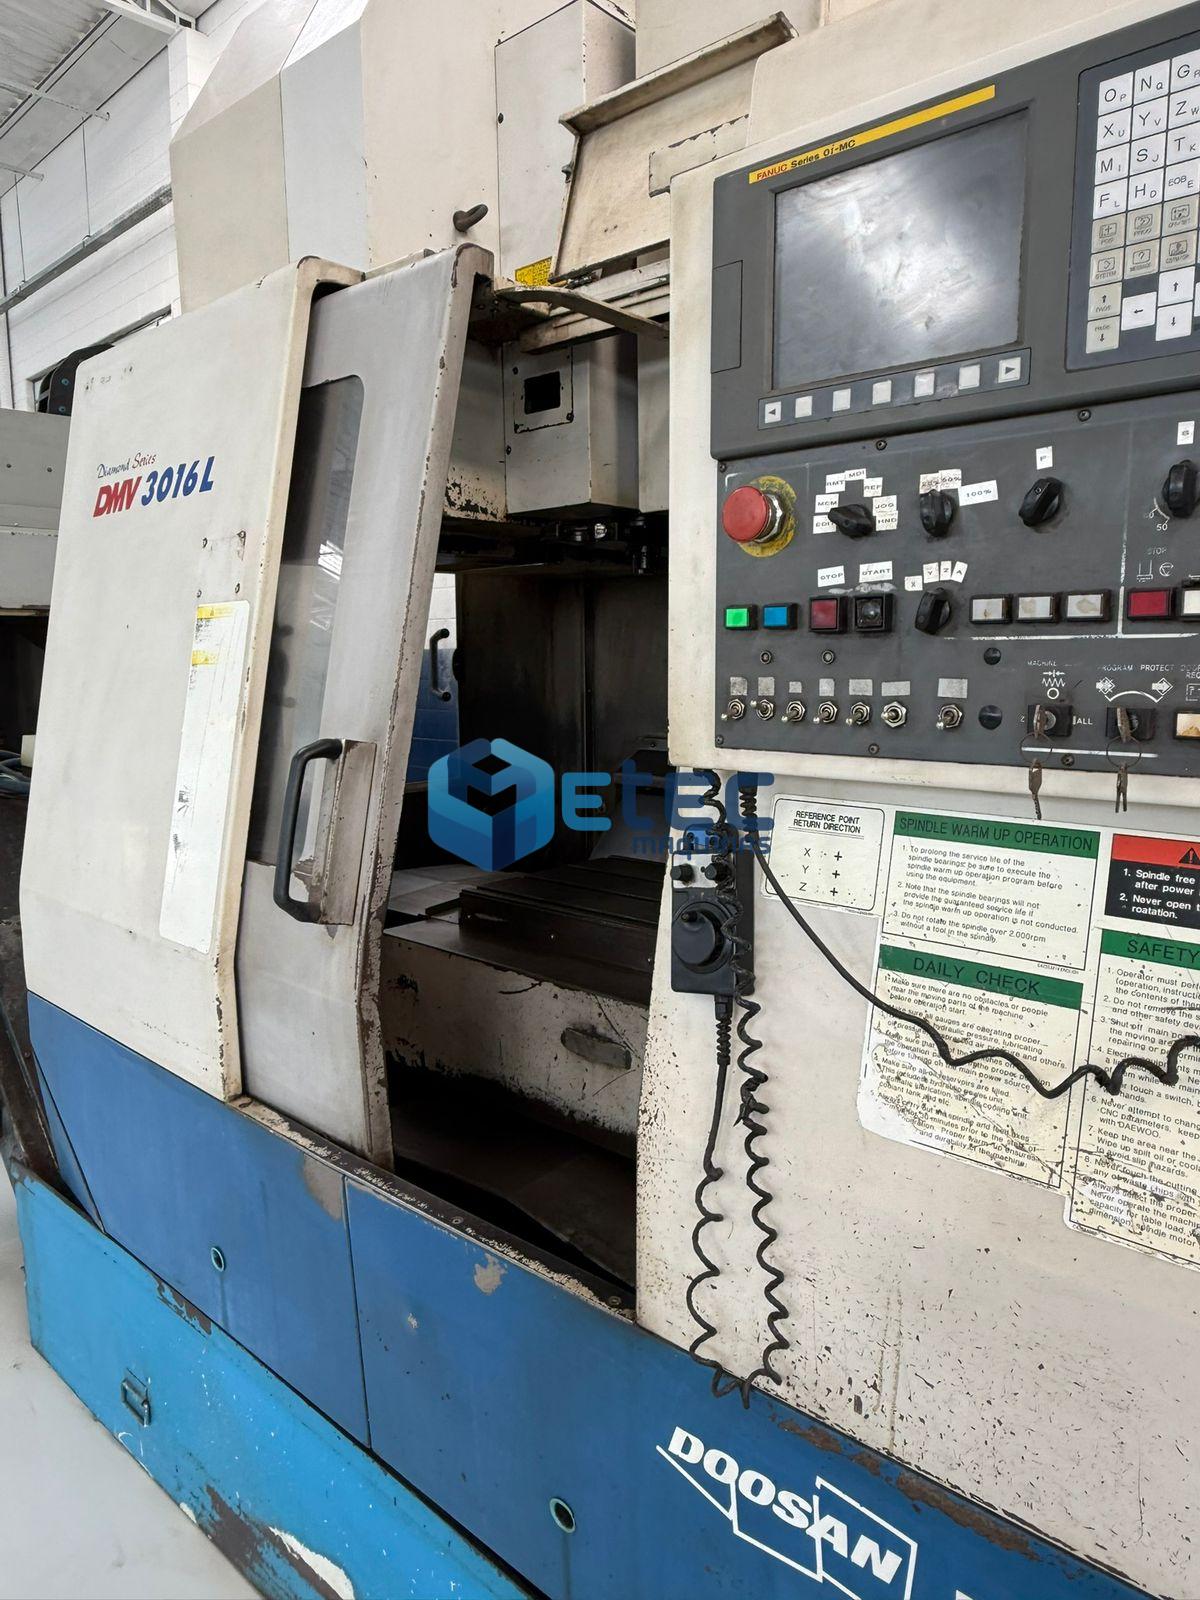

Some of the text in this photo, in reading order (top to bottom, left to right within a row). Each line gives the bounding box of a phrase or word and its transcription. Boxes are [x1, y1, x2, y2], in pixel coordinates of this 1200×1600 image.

[1177, 64, 1191, 79] G
[1140, 76, 1152, 92] N
[1104, 88, 1117, 103] O
[1175, 100, 1188, 117] Z
[1138, 111, 1151, 126] Y
[1103, 123, 1114, 138] X
[1174, 136, 1186, 151] T
[1136, 148, 1148, 162] S
[756, 163, 788, 180] FANUC
[790, 153, 820, 169] Series
[1100, 157, 1113, 173] M
[1134, 183, 1146, 199] H
[1099, 192, 1110, 208] F
[93, 456, 215, 518] DMV 3016L
[1156, 523, 1168, 531] 50
[820, 572, 844, 581] STOP
[861, 568, 891, 576] START
[795, 810, 860, 825] REFERENCE POINT
[793, 818, 861, 834] RETURN DIRECTION
[900, 817, 1093, 851] SPINDLE WARM UP OPERATION
[803, 847, 811, 857] X
[920, 847, 947, 858] prolong
[962, 853, 988, 862] service
[802, 864, 809, 874] Y
[908, 854, 1051, 879] spindle execute the
[906, 871, 924, 880] using
[907, 862, 931, 872] spindle
[933, 865, 952, 874] warm
[965, 870, 1001, 882] operation
[1002, 876, 1035, 886] program
[1037, 879, 1063, 890] before
[1123, 868, 1196, 885] 1. Spindle free
[799, 881, 807, 892] Z
[1134, 881, 1195, 896] after power
[903, 891, 930, 901] provide
[931, 895, 942, 903] the
[923, 885, 937, 893] that
[951, 890, 977, 900] spindle
[978, 893, 1011, 904] bearings
[1012, 899, 1025, 907] will
[1119, 893, 1192, 910] 2. Never open
[974, 911, 1010, 922] operation
[1020, 919, 1033, 927] not
[1131, 905, 1178, 919] roatation.
[900, 920, 924, 930] without
[956, 929, 968, 938] the
[948, 920, 960, 928] the
[962, 922, 988, 932] spindle
[989, 927, 1007, 936] over
[1127, 939, 1200, 964] SAFETY
[913, 957, 965, 979] DAILY
[975, 969, 1040, 996] CHECK
[1117, 968, 1154, 982] Operator
[1156, 976, 1178, 986] must
[911, 982, 927, 990] sure
[928, 984, 947, 994] there
[948, 990, 960, 998] are
[1021, 1006, 1049, 1017] people
[1115, 987, 1128, 995] the
[1131, 990, 1168, 1003] contents
[991, 1007, 1024, 1020] machine
[1113, 997, 1125, 1005] Do
[1127, 1000, 1142, 1009] not
[1179, 1010, 1193, 1020] the
[1112, 1007, 1181, 1027] and other safety
[1109, 1027, 1156, 1044] the moving
[1148, 1027, 1169, 1037] main
[1108, 1036, 1146, 1051] repairing
[1022, 1053, 1038, 1062] and
[1130, 1083, 1154, 1095] touch
[1100, 1107, 1118, 1118] CNC
[1101, 1098, 1125, 1110] Never
[1128, 1105, 1160, 1120] attempt
[1099, 1116, 1119, 1127] with
[1097, 1127, 1180, 1156] Keep the area near
[1097, 1136, 1118, 1148] Wipe
[1118, 1198, 1151, 1214] operate
[1166, 1204, 1196, 1218] proper
[1141, 1214, 1162, 1226] table
[1169, 1233, 1196, 1247] motor
[668, 1426, 902, 1584] DOOSAN
